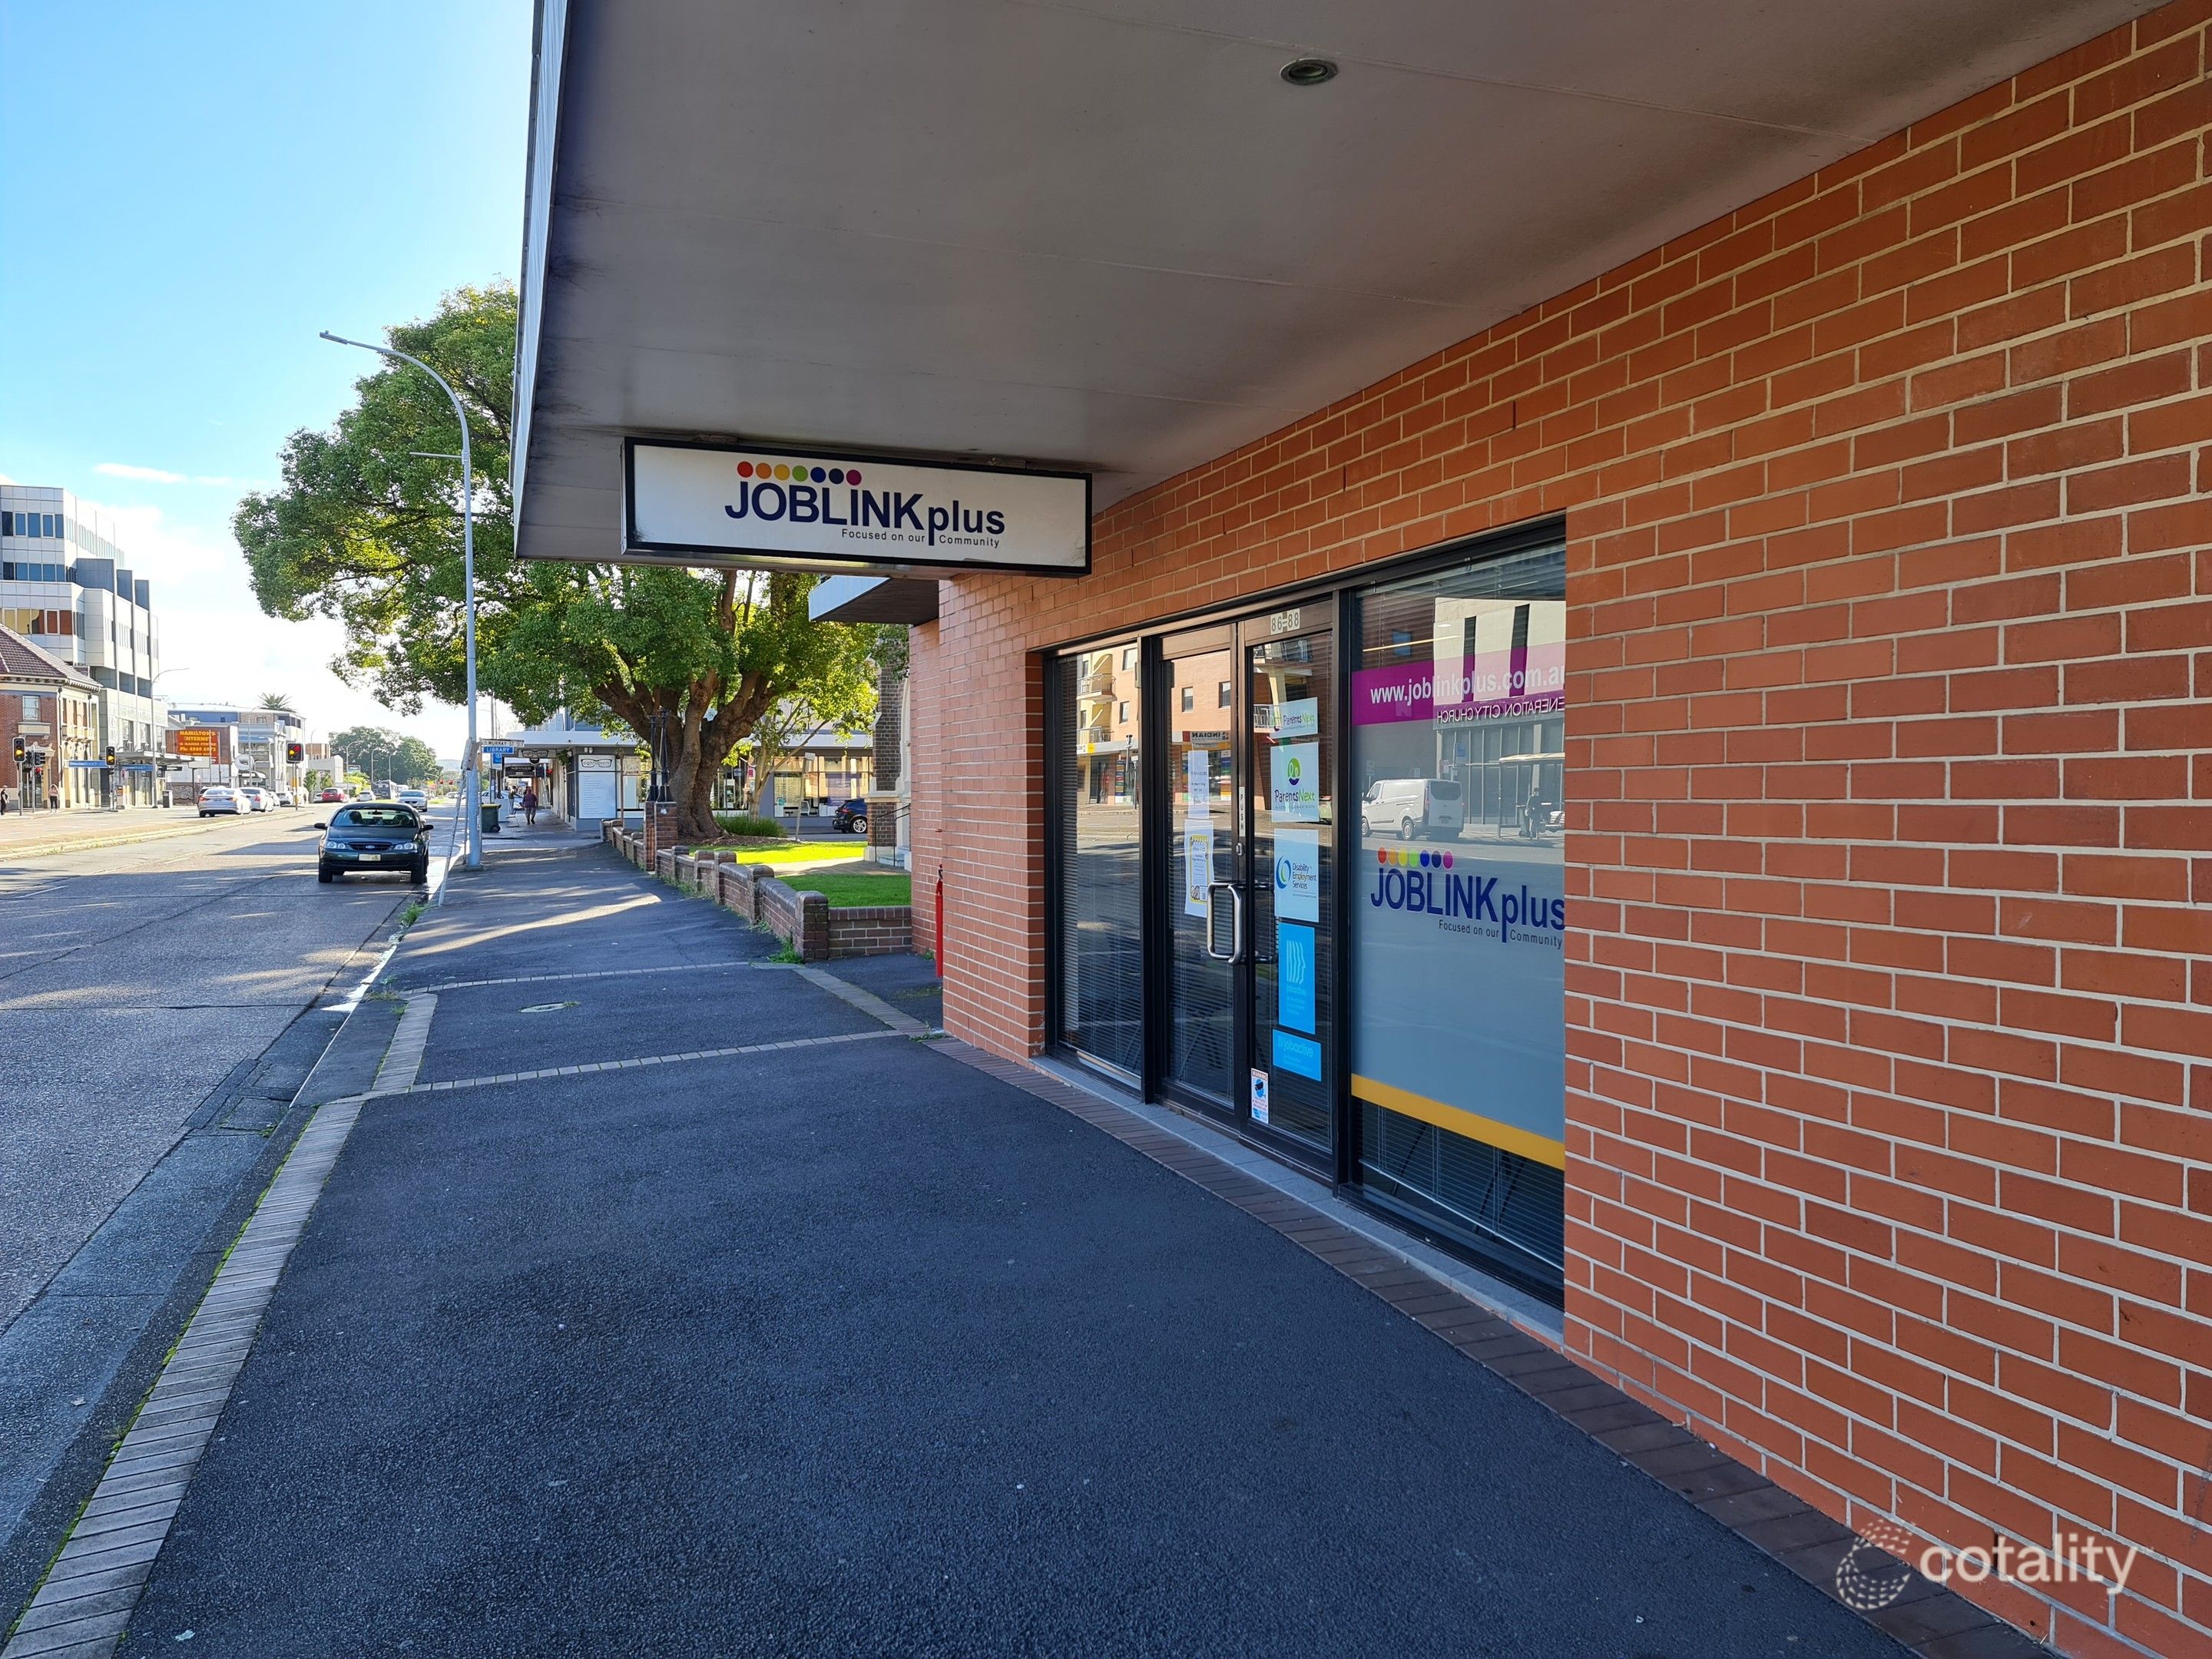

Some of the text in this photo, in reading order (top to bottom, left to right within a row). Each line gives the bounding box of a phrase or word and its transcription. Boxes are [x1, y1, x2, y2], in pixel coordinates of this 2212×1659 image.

[842, 528, 887, 541] Focused
[939, 535, 999, 548] Community
[1271, 612, 1300, 632] 86-88
[1283, 712, 1315, 725] ParentsNext
[1274, 788, 1315, 803] ParentsNext
[1293, 863, 1310, 873] Disability
[1293, 872, 1316, 882] Employment
[1293, 880, 1308, 889] Services
[1439, 919, 1563, 949] Focused on our Community
